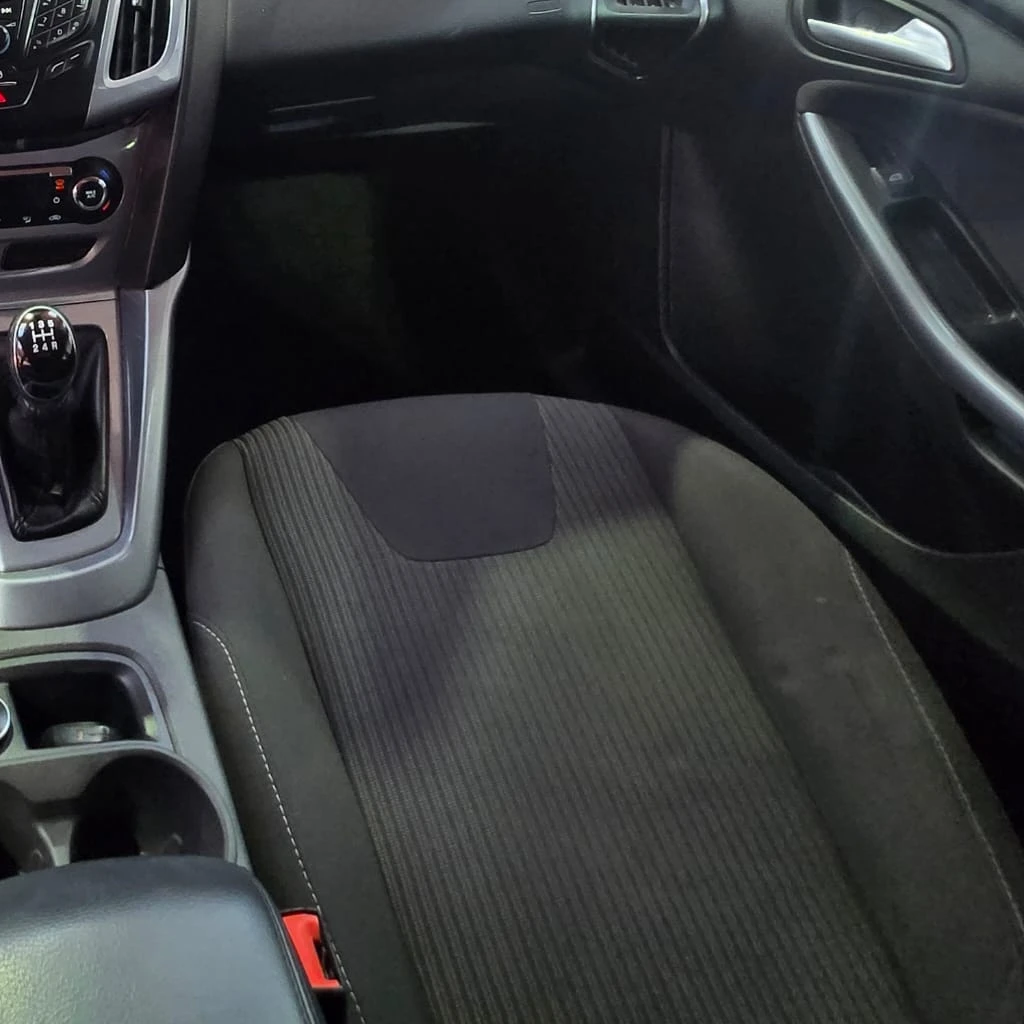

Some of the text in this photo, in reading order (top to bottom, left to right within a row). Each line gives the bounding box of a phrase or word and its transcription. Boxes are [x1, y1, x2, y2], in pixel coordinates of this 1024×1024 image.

[29, 320, 54, 330] 1 3 5
[33, 341, 58, 353] 2 4 R
